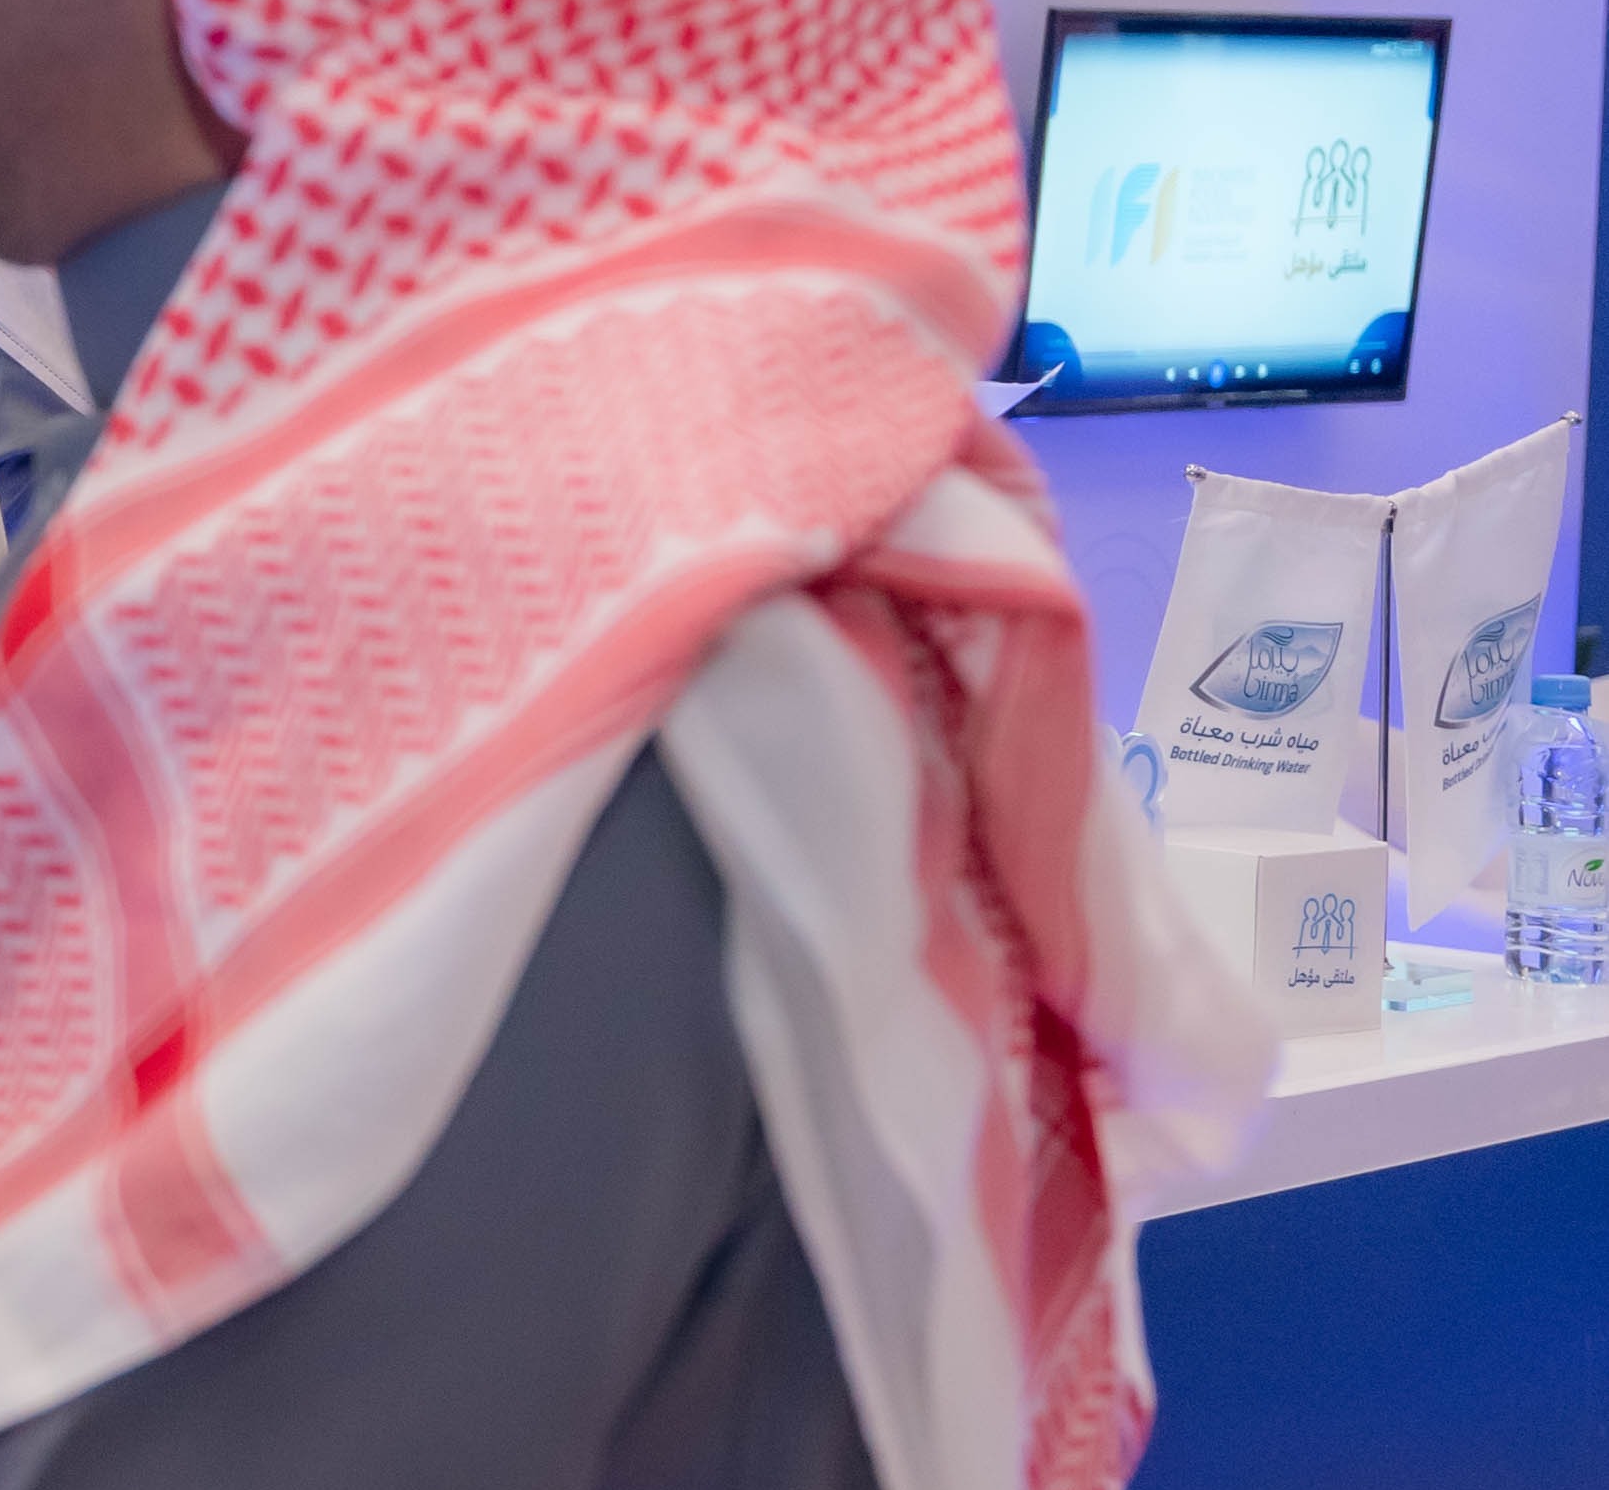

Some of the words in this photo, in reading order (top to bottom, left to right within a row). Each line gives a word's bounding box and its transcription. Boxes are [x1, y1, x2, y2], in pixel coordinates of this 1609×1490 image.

[1469, 667, 1517, 705] birm
[1179, 715, 1234, 743] معبأة
[1240, 727, 1283, 750] شرب
[1286, 732, 1320, 754] مياه
[1170, 745, 1221, 766] Bottled
[1221, 752, 1274, 776] Drinking
[1275, 760, 1311, 775] Water
[1288, 967, 1321, 988] مؤهل
[1323, 968, 1356, 988] ملتقى
